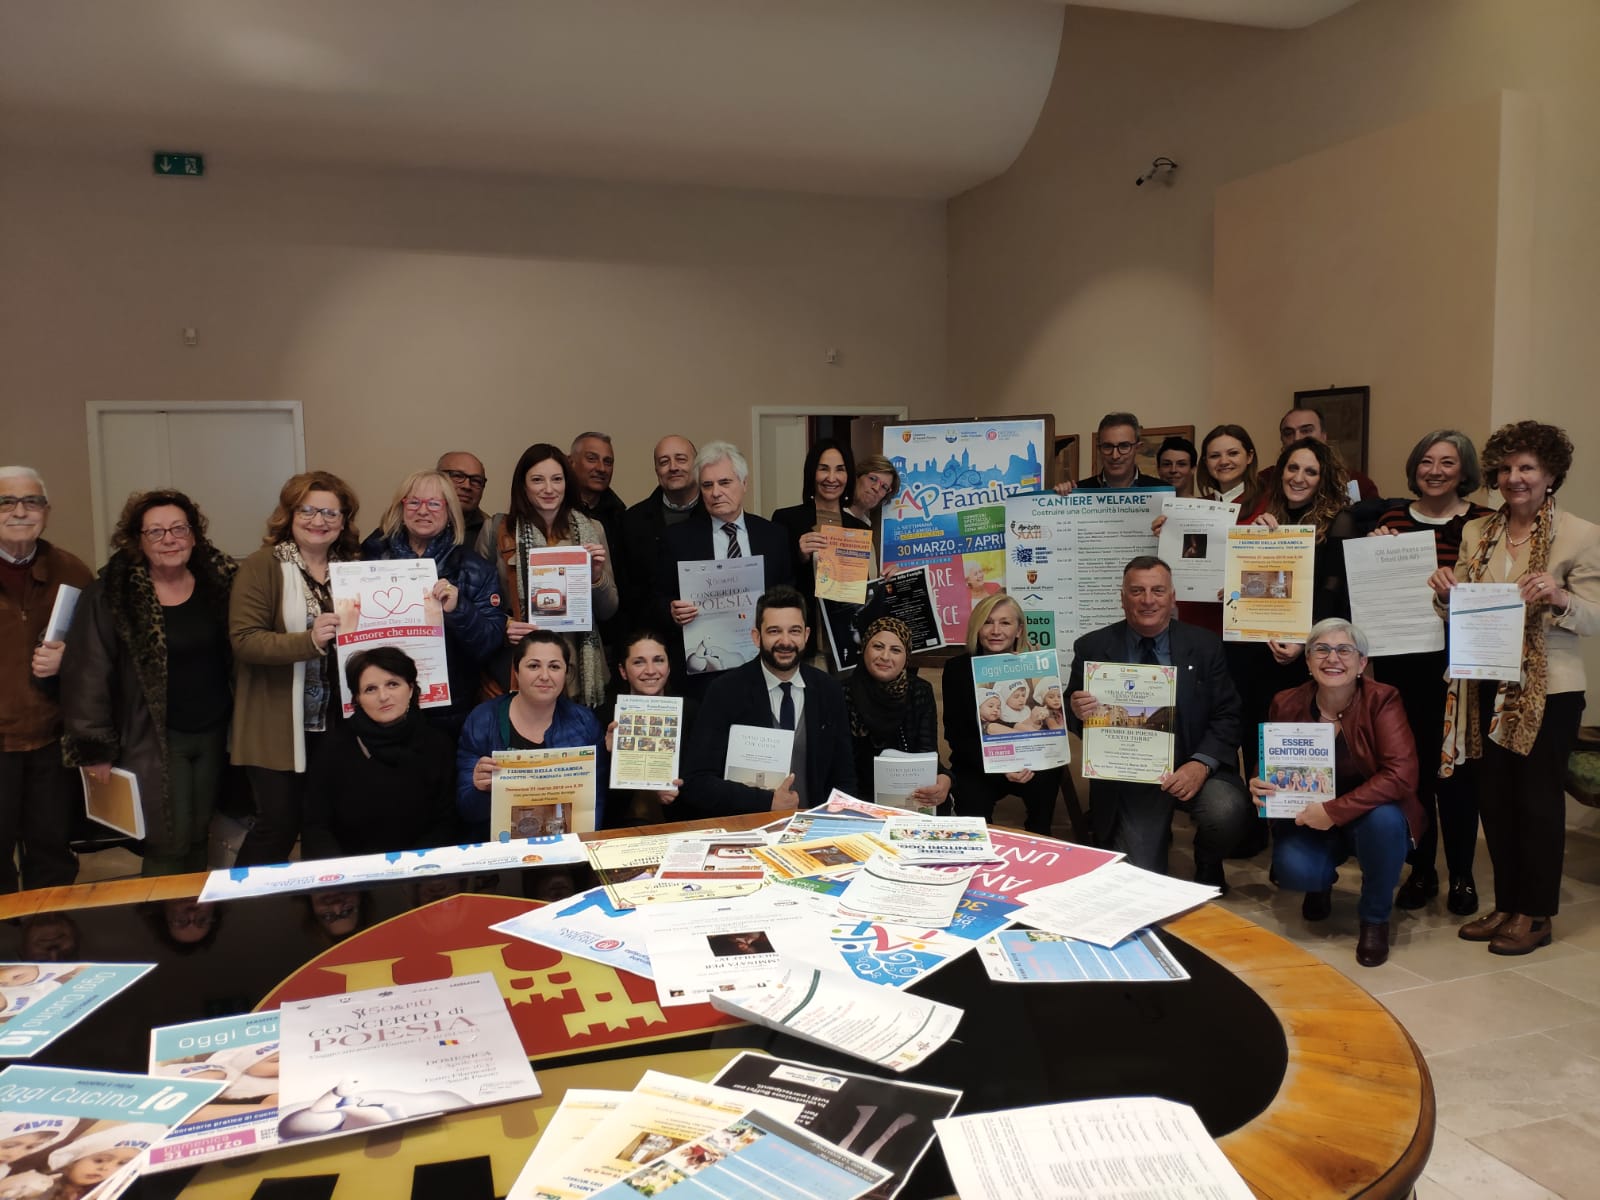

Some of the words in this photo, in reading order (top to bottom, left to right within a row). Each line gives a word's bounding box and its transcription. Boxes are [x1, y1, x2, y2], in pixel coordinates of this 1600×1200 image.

[942, 481, 1019, 510] Family
[1096, 494, 1152, 506] WELFARE"
[1032, 508, 1065, 517] Costruire
[1081, 507, 1117, 515] Comunità
[1118, 506, 1150, 514] Inclusiva
[897, 546, 911, 557] 30
[912, 540, 956, 555] MARZO
[965, 537, 973, 549] 7
[974, 533, 1006, 548] APRI
[1026, 615, 1050, 625] bato
[344, 630, 384, 644] L'amore
[387, 627, 403, 638] che
[406, 627, 437, 636] unisce
[1027, 631, 1051, 646] 30
[1282, 738, 1314, 747] ESSERE
[1268, 747, 1307, 756] GENITORI
[1308, 748, 1329, 757] OGGI
[308, 1010, 440, 1039] CONCERTO
[448, 1006, 464, 1017] di
[313, 1016, 476, 1053] POESIA
[50, 1086, 139, 1108] Cucino
[811, 1095, 830, 1104] tutti
[213, 1116, 243, 1128] pratico
[188, 1138, 243, 1157] marzo
